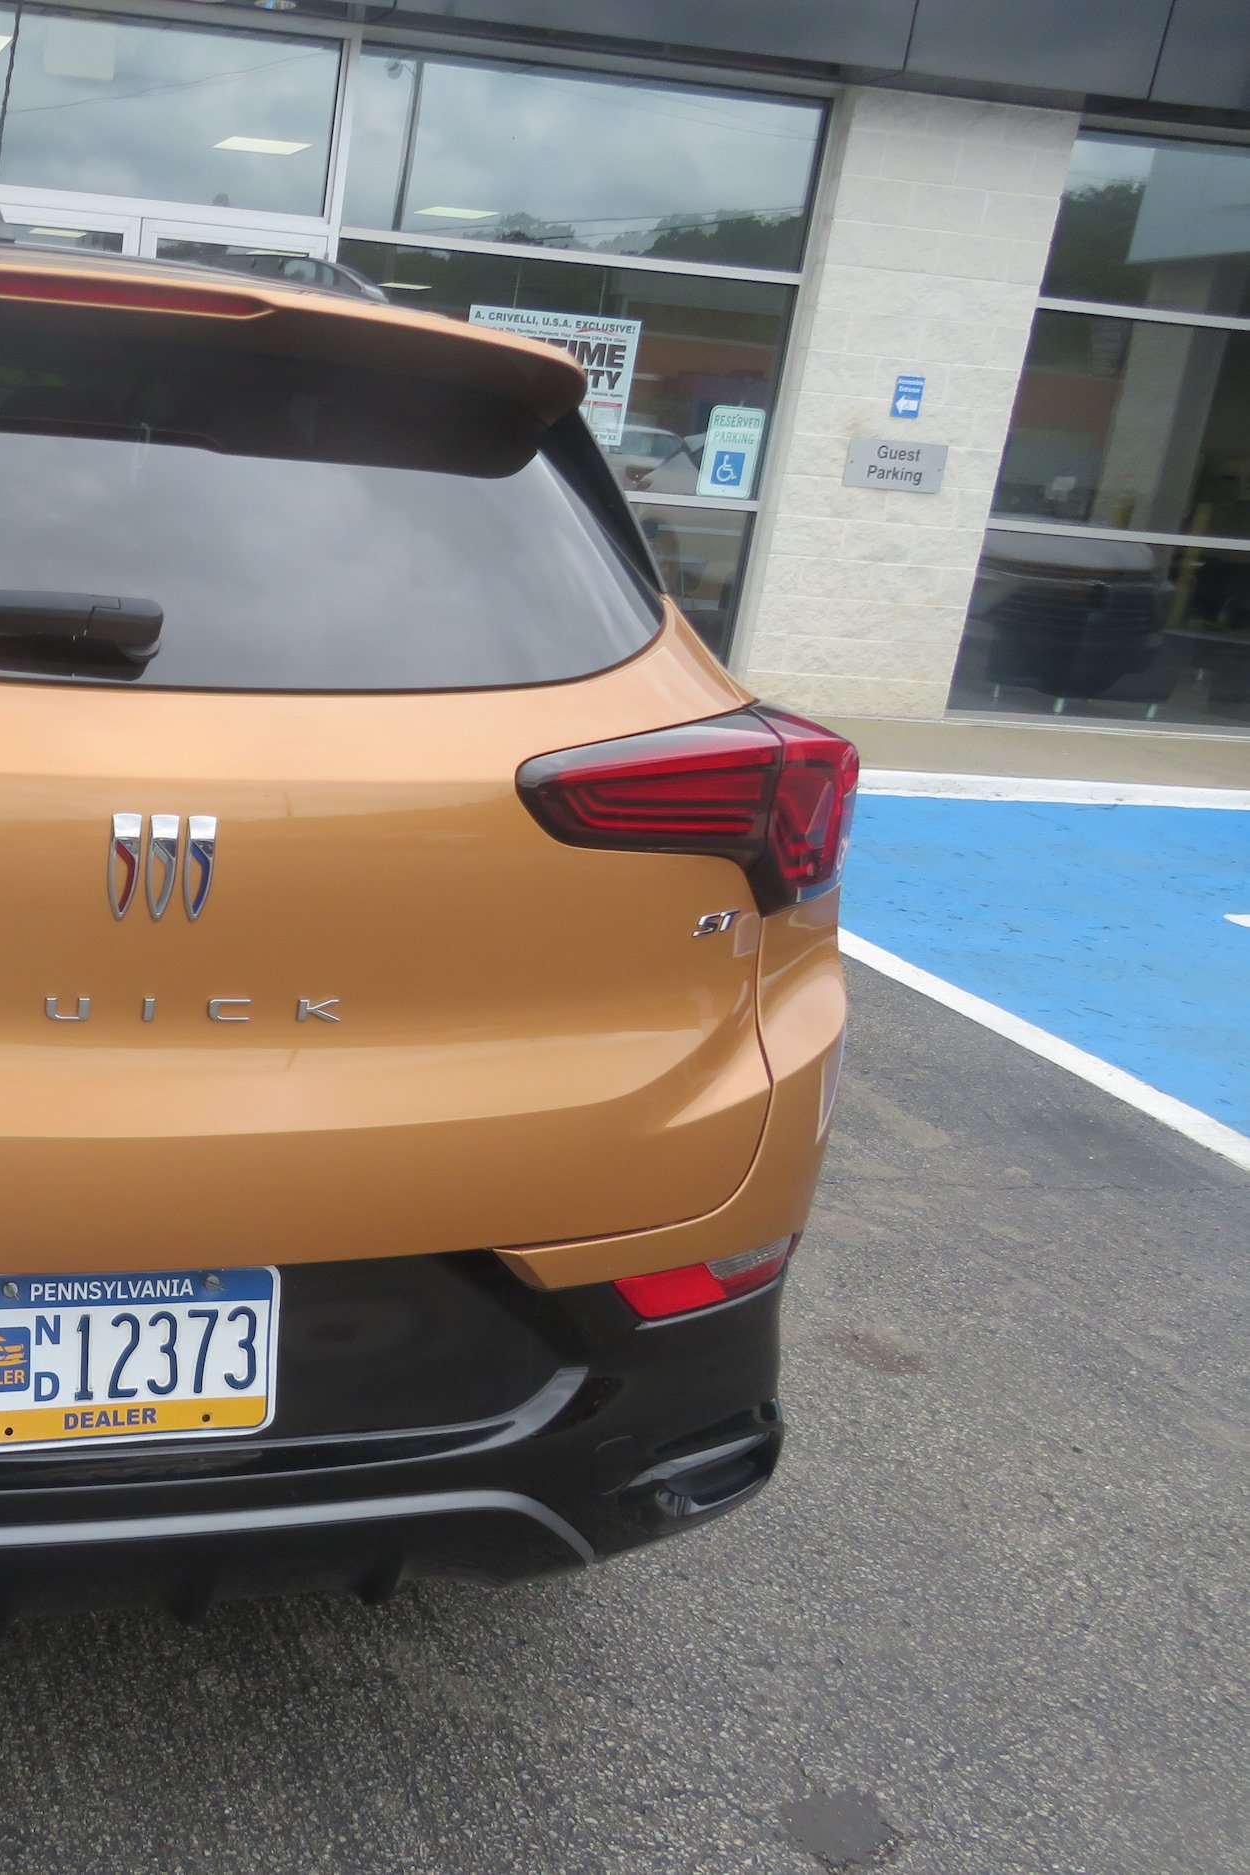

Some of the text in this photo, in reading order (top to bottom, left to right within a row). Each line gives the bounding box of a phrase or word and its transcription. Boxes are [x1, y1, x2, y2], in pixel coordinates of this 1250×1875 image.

[474, 310, 636, 335] A. CRIVELLI, U.S.A. EXCLUSIVE!
[713, 414, 760, 429] RESERVED
[713, 430, 755, 445] PARKING
[877, 445, 921, 462] Guest
[866, 465, 922, 486] Parking
[692, 908, 741, 938] ST
[30, 1278, 194, 1302] PENNSYLVANIA
[74, 1306, 257, 1402] 12373
[63, 1407, 158, 1431] DEALER
